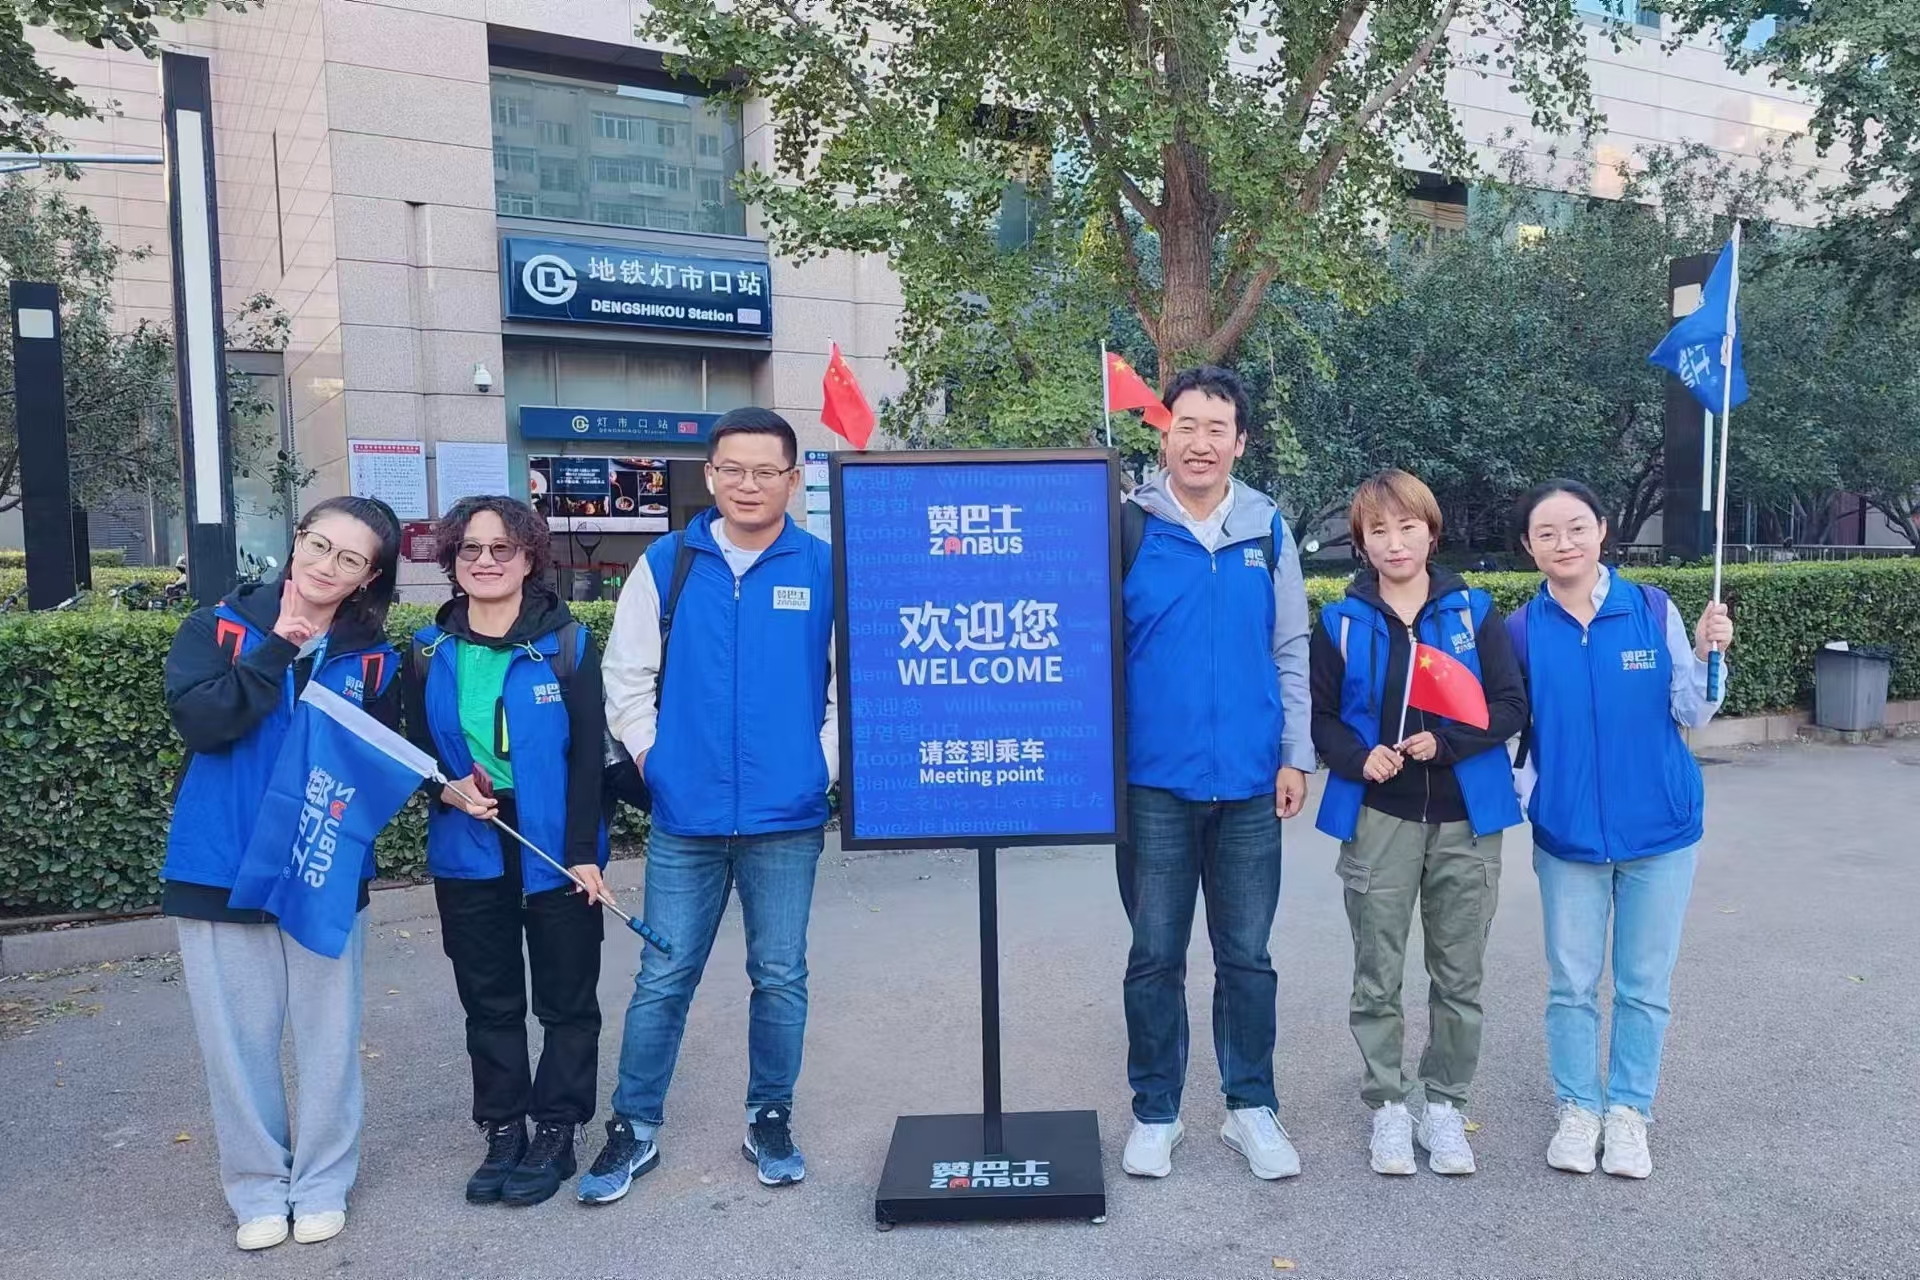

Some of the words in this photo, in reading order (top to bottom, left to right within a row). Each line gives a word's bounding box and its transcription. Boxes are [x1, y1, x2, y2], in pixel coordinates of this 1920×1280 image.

[588, 256, 762, 297] 地铁灯市口站
[591, 299, 686, 320] DENGSHIKOU
[687, 307, 734, 323] Station
[596, 416, 668, 430] 灯市口站
[928, 504, 1023, 534] 赞巴士
[930, 535, 1023, 556] ZANBUS
[898, 599, 1060, 653] 欢迎您
[897, 655, 1063, 686] WELCOME
[919, 738, 1045, 766] 请签到乘车
[919, 767, 993, 787] Meeting
[996, 765, 1045, 787] point
[932, 1160, 1050, 1178] 赞巴士
[929, 1176, 1050, 1189] ZANBUS
